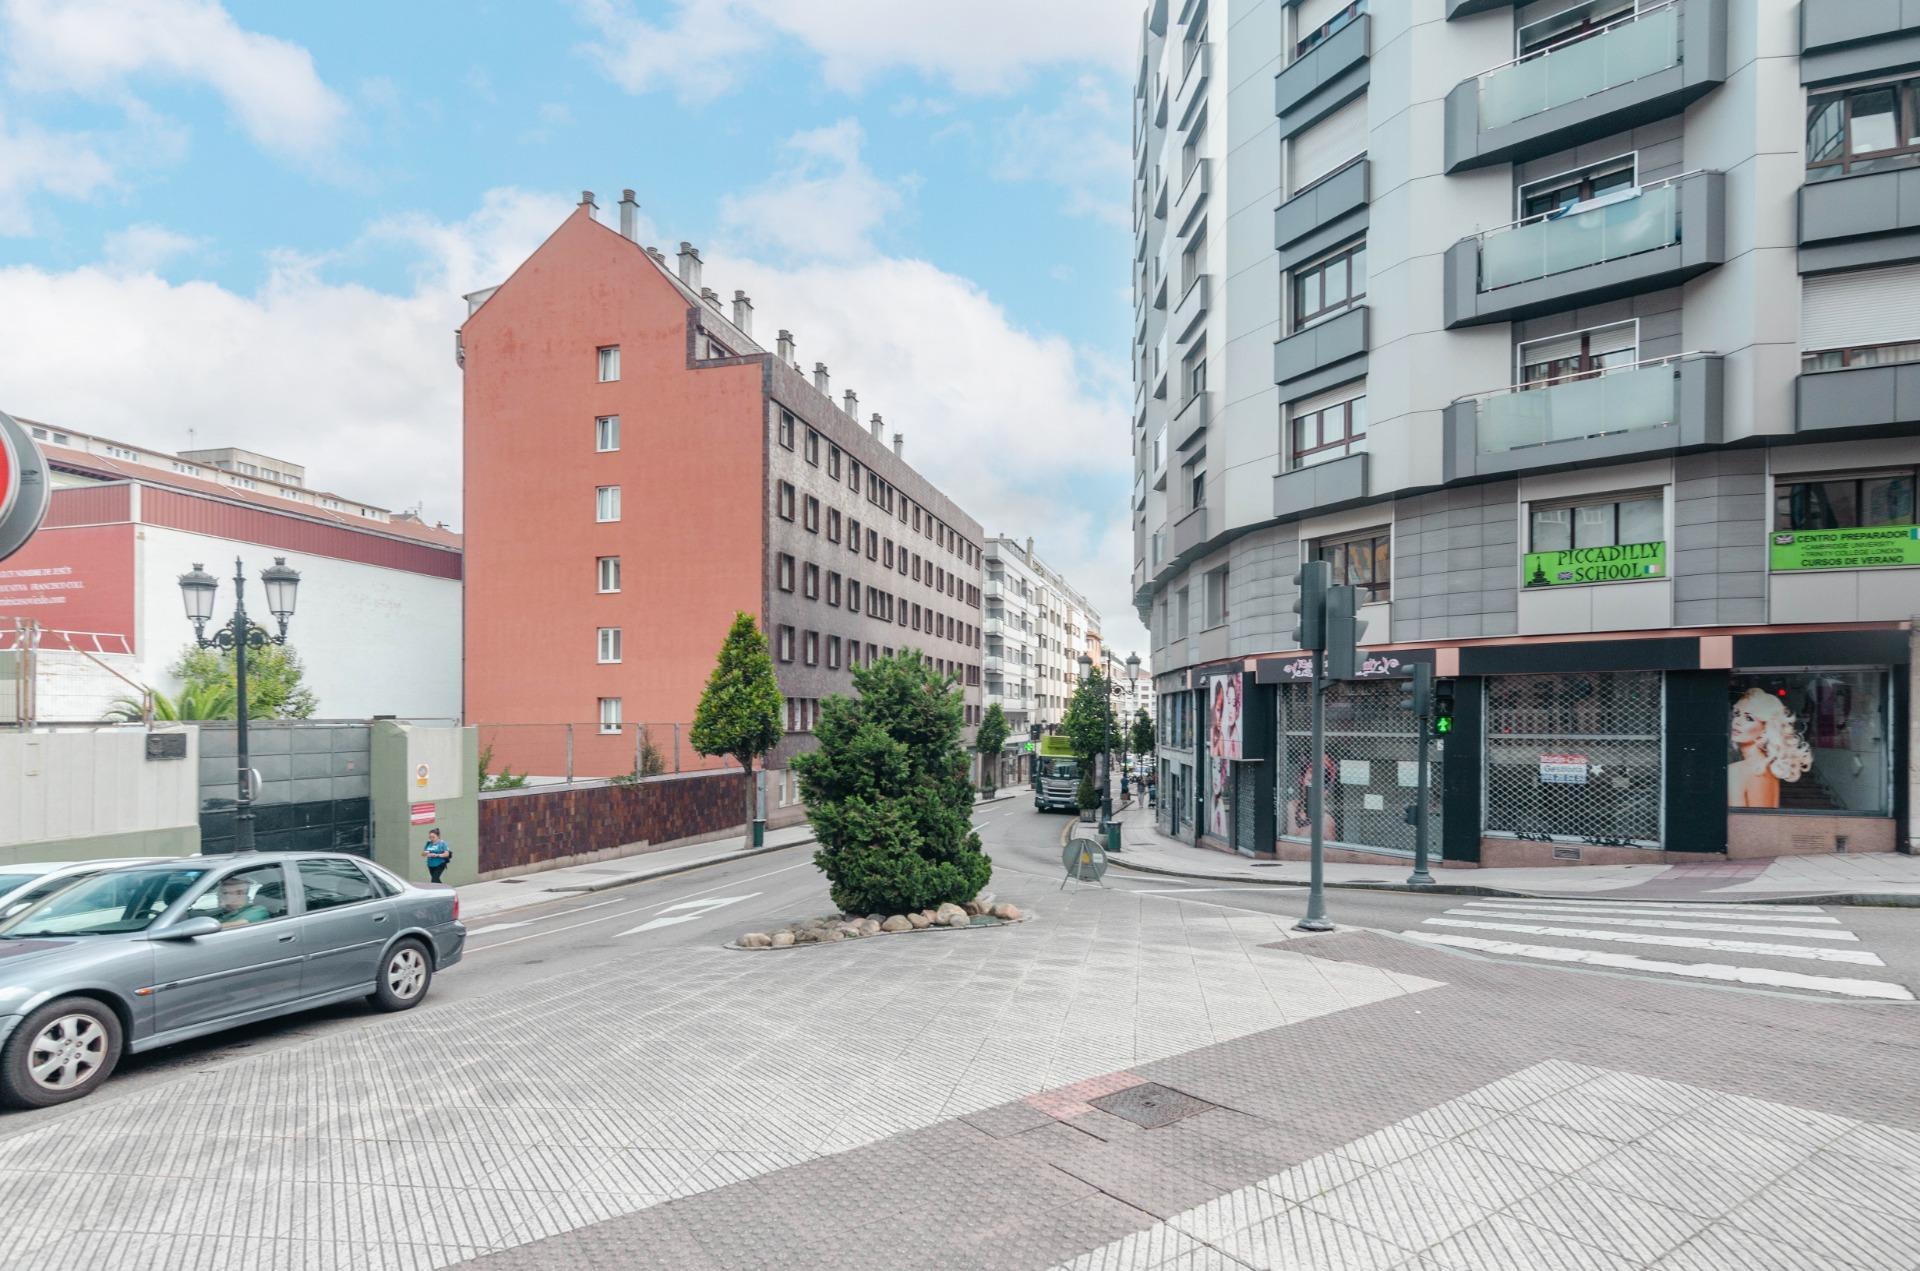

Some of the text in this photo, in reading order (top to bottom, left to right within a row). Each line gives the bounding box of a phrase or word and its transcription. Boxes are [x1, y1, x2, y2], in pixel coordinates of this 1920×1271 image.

[1797, 530, 1909, 543] CENTRO PREPARADOR
[1557, 541, 1660, 566] PICCADILLY
[1801, 555, 1904, 567] CURSOS DE VERANO
[1575, 562, 1642, 582] SCHOOL
